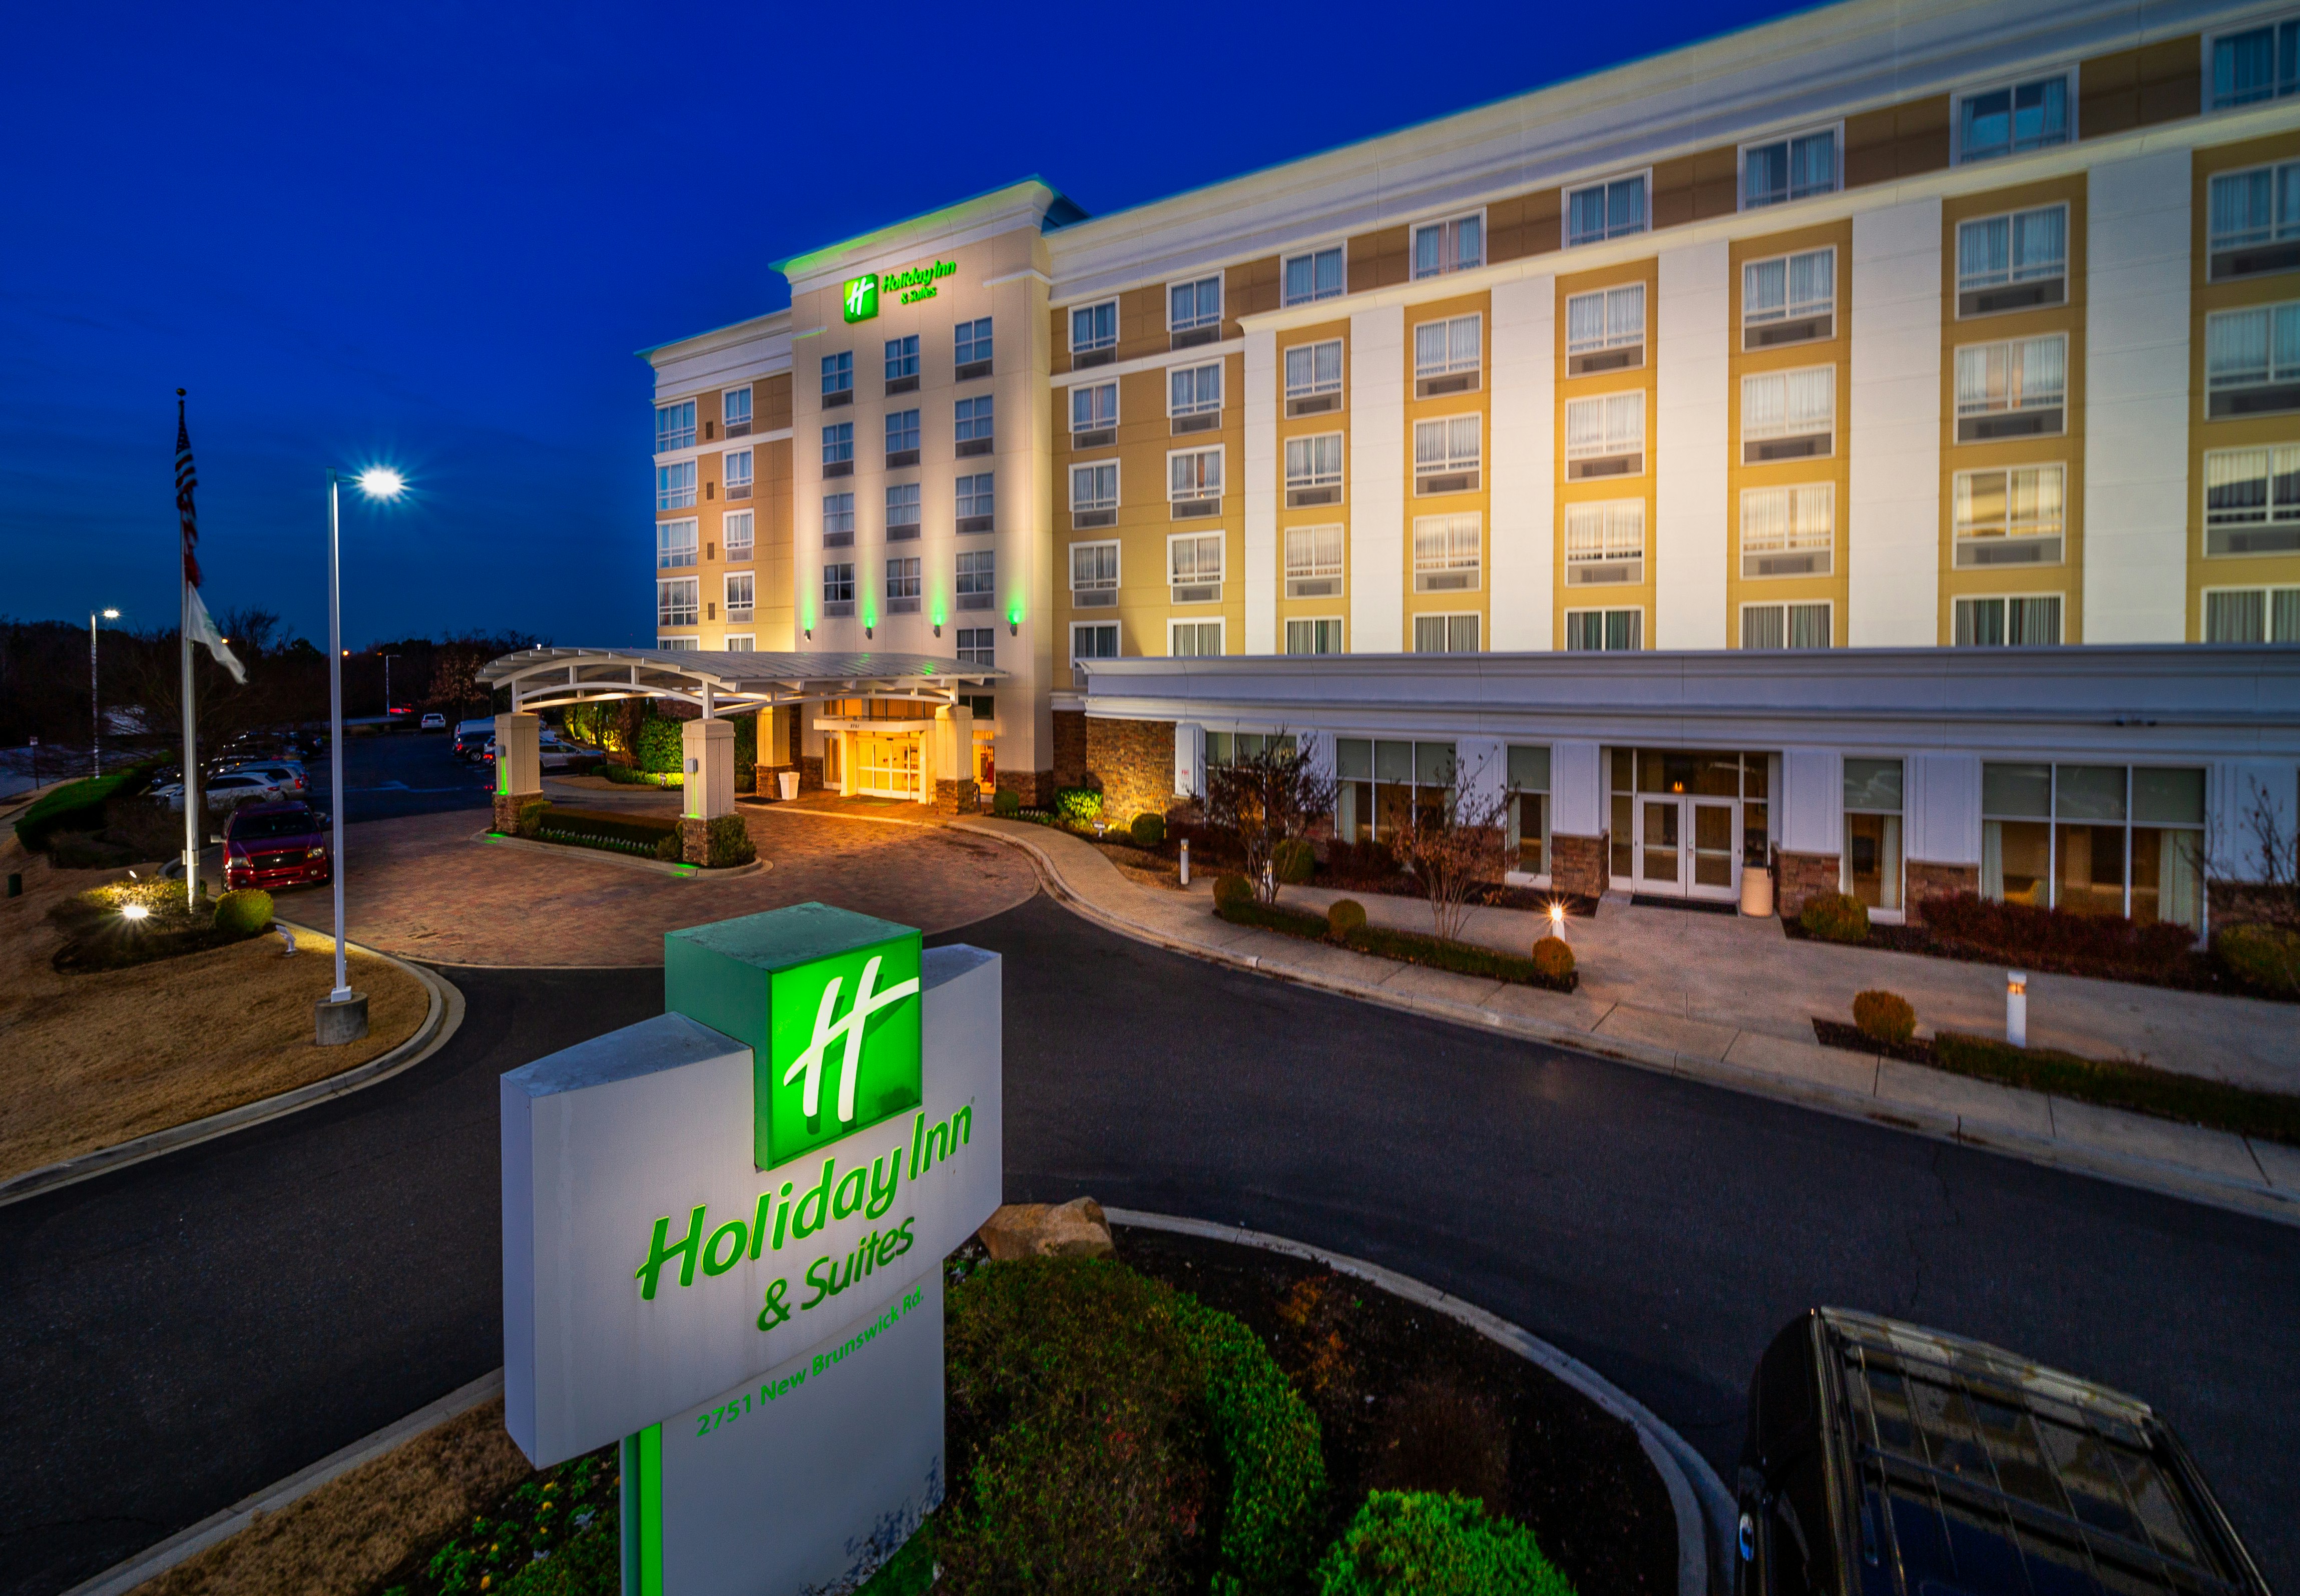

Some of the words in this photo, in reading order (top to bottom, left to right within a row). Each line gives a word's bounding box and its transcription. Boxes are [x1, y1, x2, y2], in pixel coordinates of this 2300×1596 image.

[881, 267, 934, 292] Holiday
[933, 260, 957, 278] Inn
[900, 291, 908, 304] &
[909, 286, 937, 302] Suites
[635, 1156, 903, 1301] Holiday
[907, 1105, 973, 1181] Inn
[756, 1278, 791, 1332] &
[801, 1216, 915, 1311] Suites
[696, 1393, 752, 1437] 2751
[760, 1368, 807, 1405] New
[812, 1305, 899, 1377] Brunswick
[902, 1284, 924, 1315] Rd.
